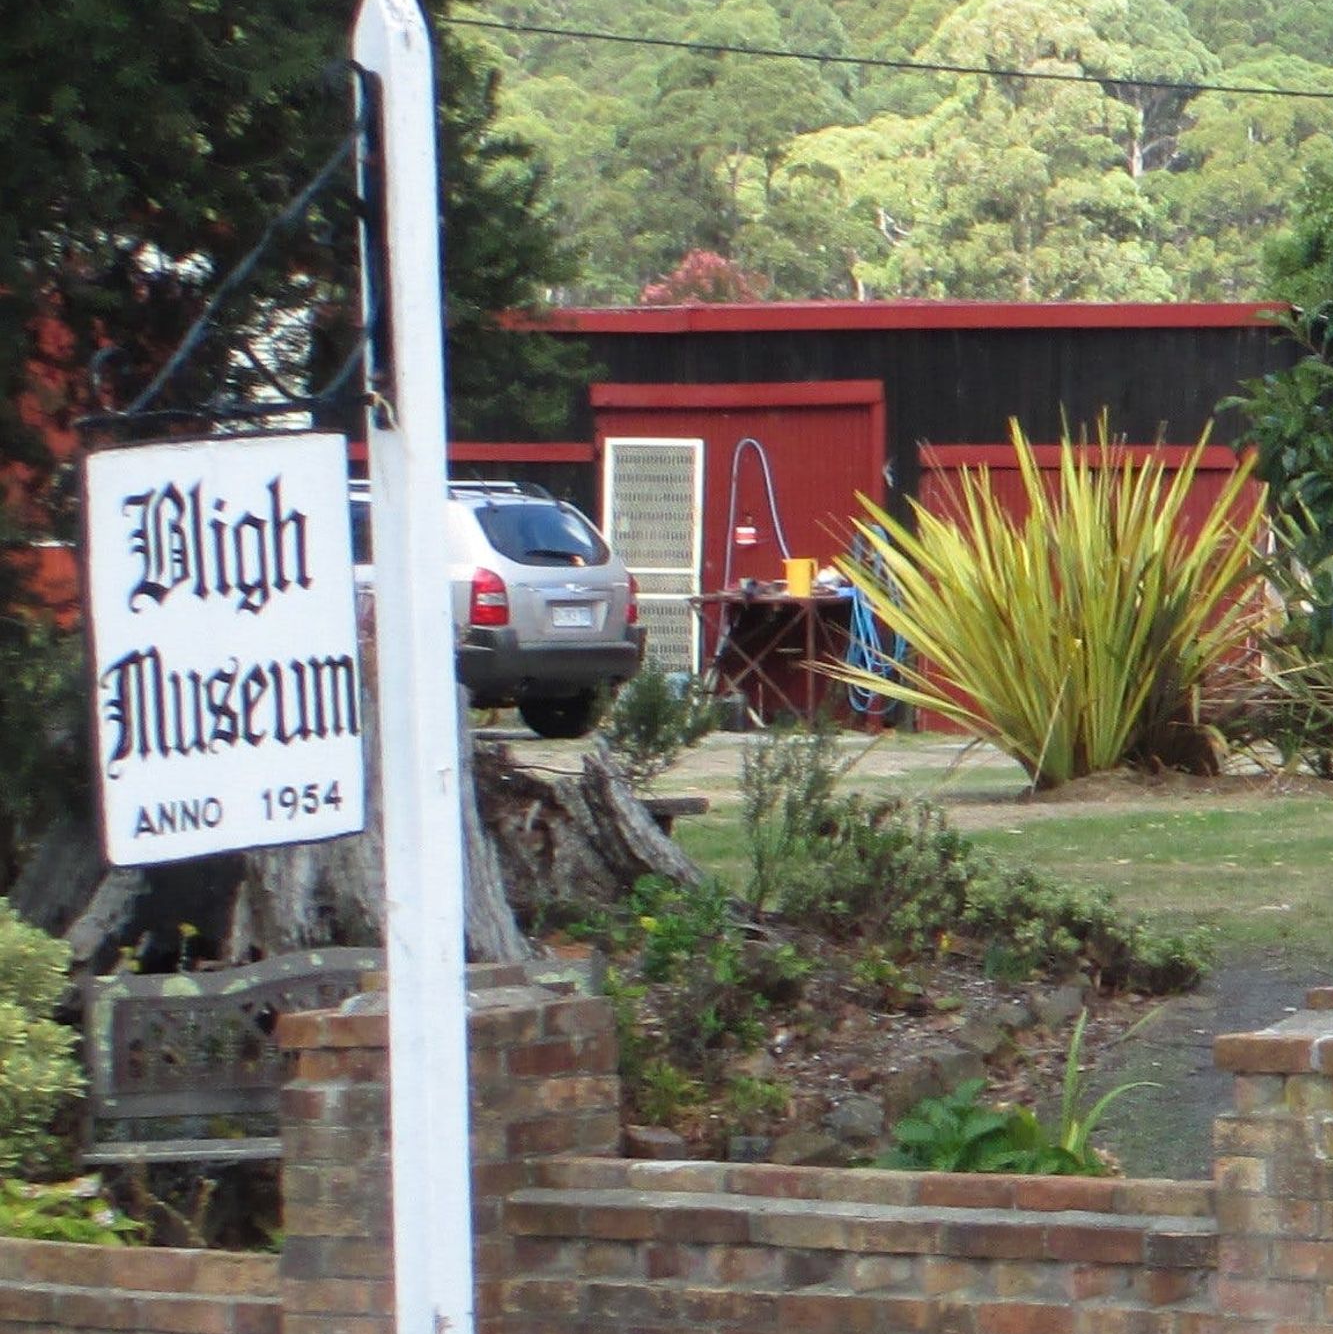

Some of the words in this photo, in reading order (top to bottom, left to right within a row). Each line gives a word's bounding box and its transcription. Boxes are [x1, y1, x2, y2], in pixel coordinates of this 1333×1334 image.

[122, 475, 313, 614] Bligh
[103, 644, 361, 780] Museum
[134, 796, 223, 839] ANNO
[260, 780, 343, 821] 1954
